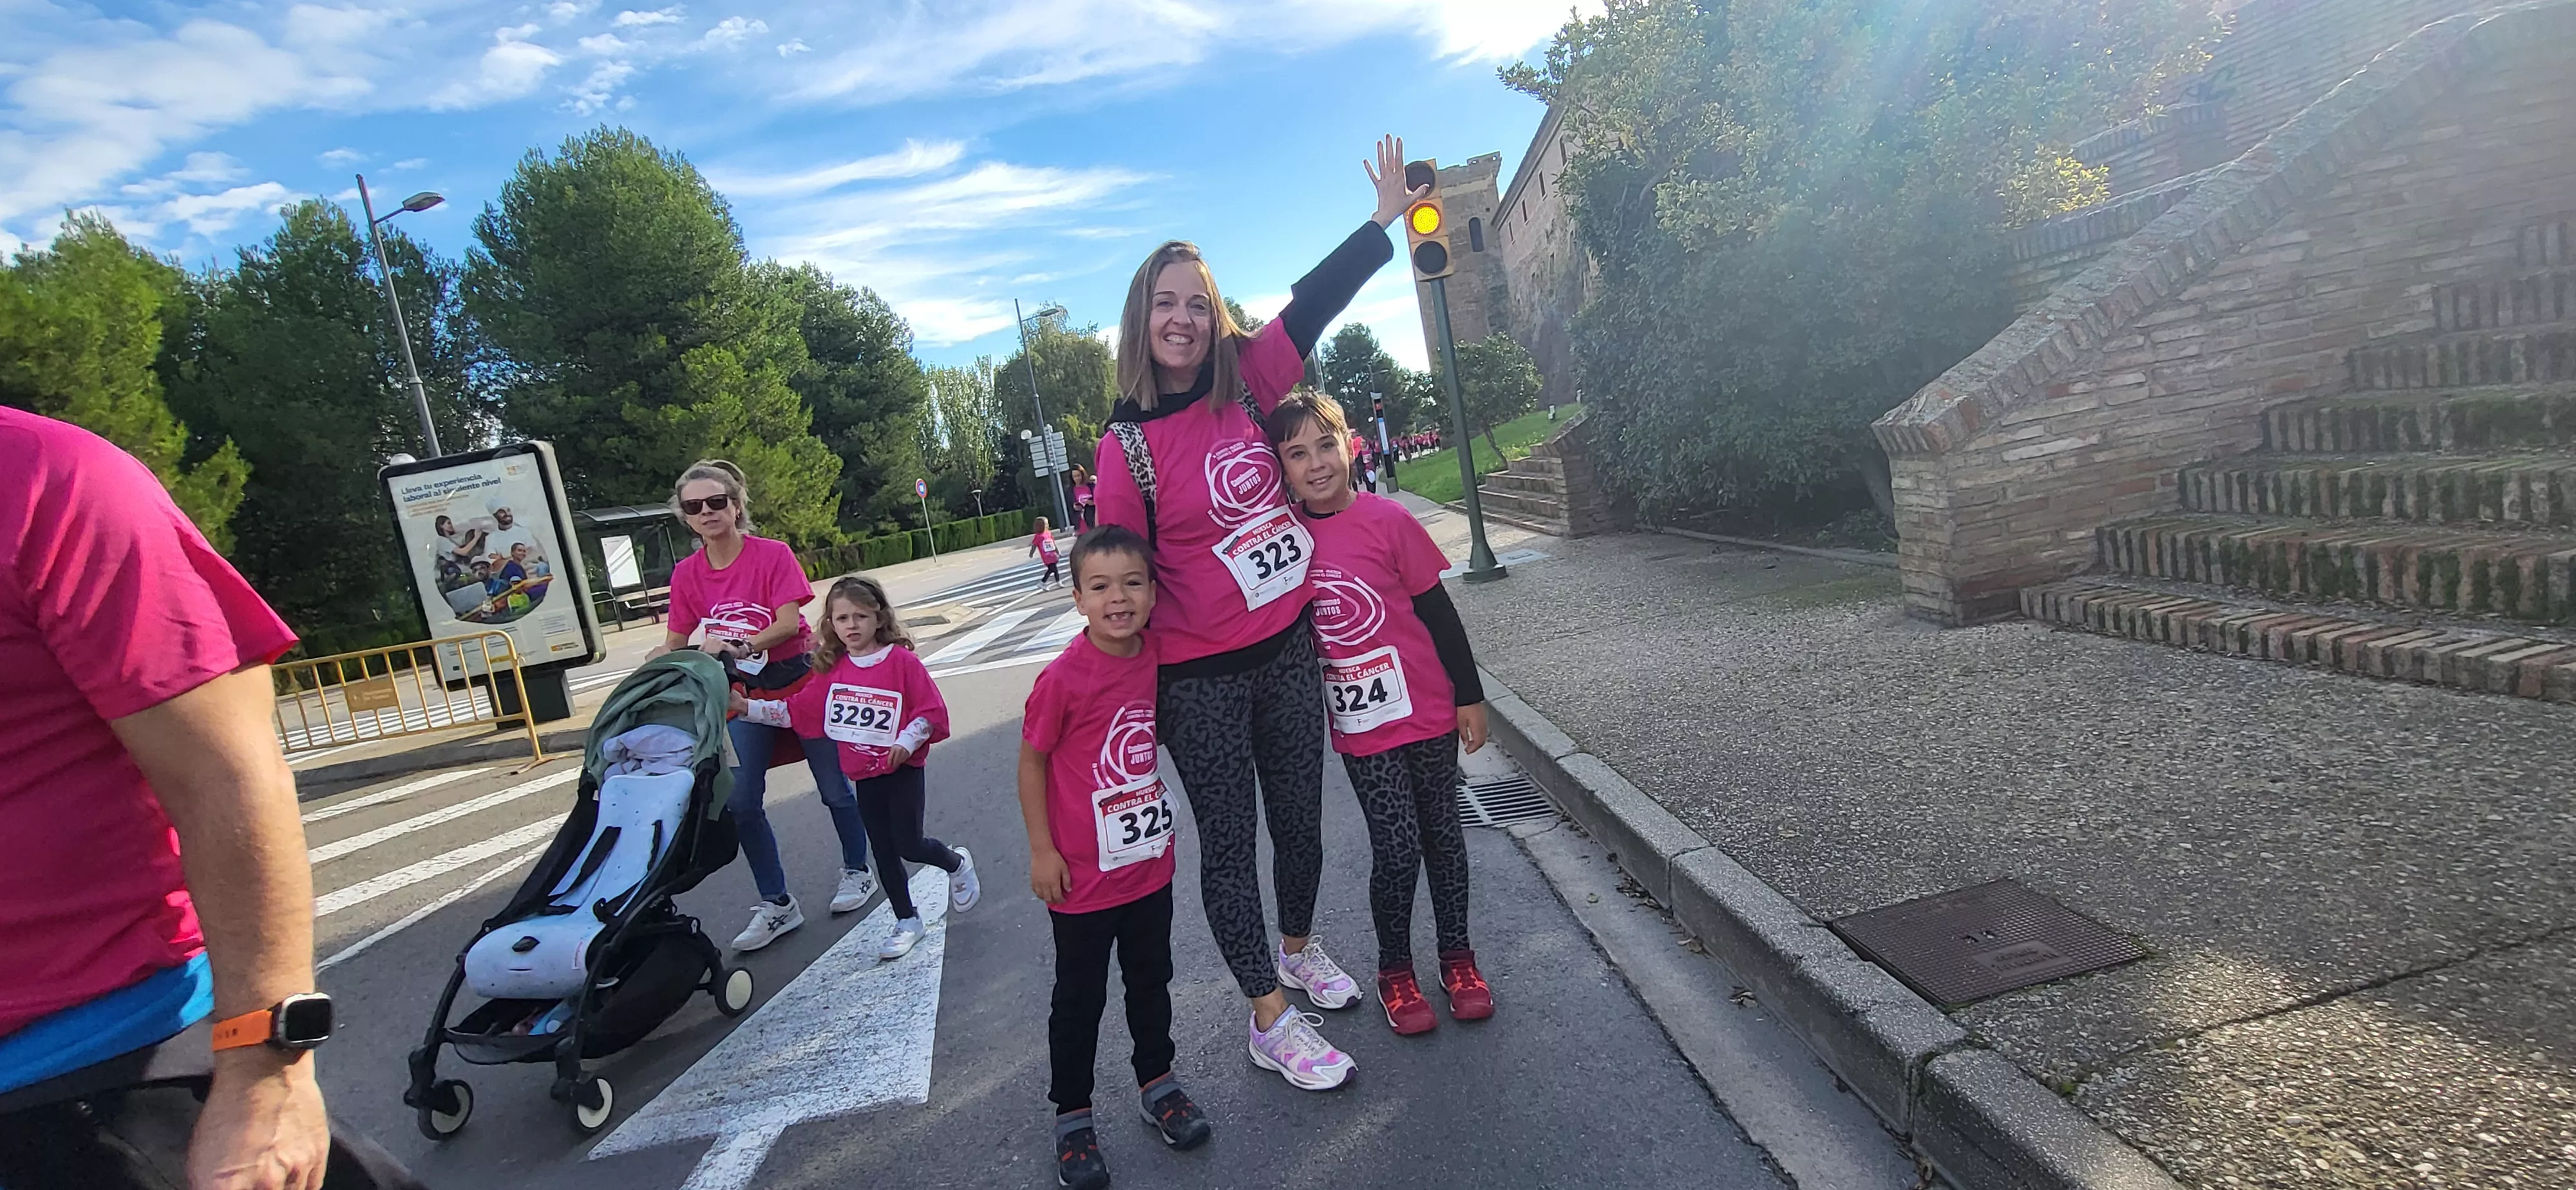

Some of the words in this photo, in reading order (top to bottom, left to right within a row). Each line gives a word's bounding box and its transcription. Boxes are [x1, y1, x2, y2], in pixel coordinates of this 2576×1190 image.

[401, 485, 422, 495] Lleva
[434, 473, 483, 489] experiencia
[402, 490, 432, 502] laboral
[433, 488, 442, 496] al
[482, 477, 502, 487] nivel
[1238, 473, 1261, 495] JUNTOS
[1233, 535, 1263, 555] CONTRA
[1272, 521, 1293, 536] CÁNCER
[1252, 522, 1273, 535] HUESCA
[1248, 534, 1302, 580] 323
[1357, 662, 1390, 679] CÁNCER
[867, 698, 894, 708] CÁNCER
[1332, 677, 1388, 712] 324
[831, 703, 892, 730] 3292
[1107, 797, 1142, 813] CONTRA
[1144, 793, 1153, 802] EL
[1119, 799, 1173, 845] 325
